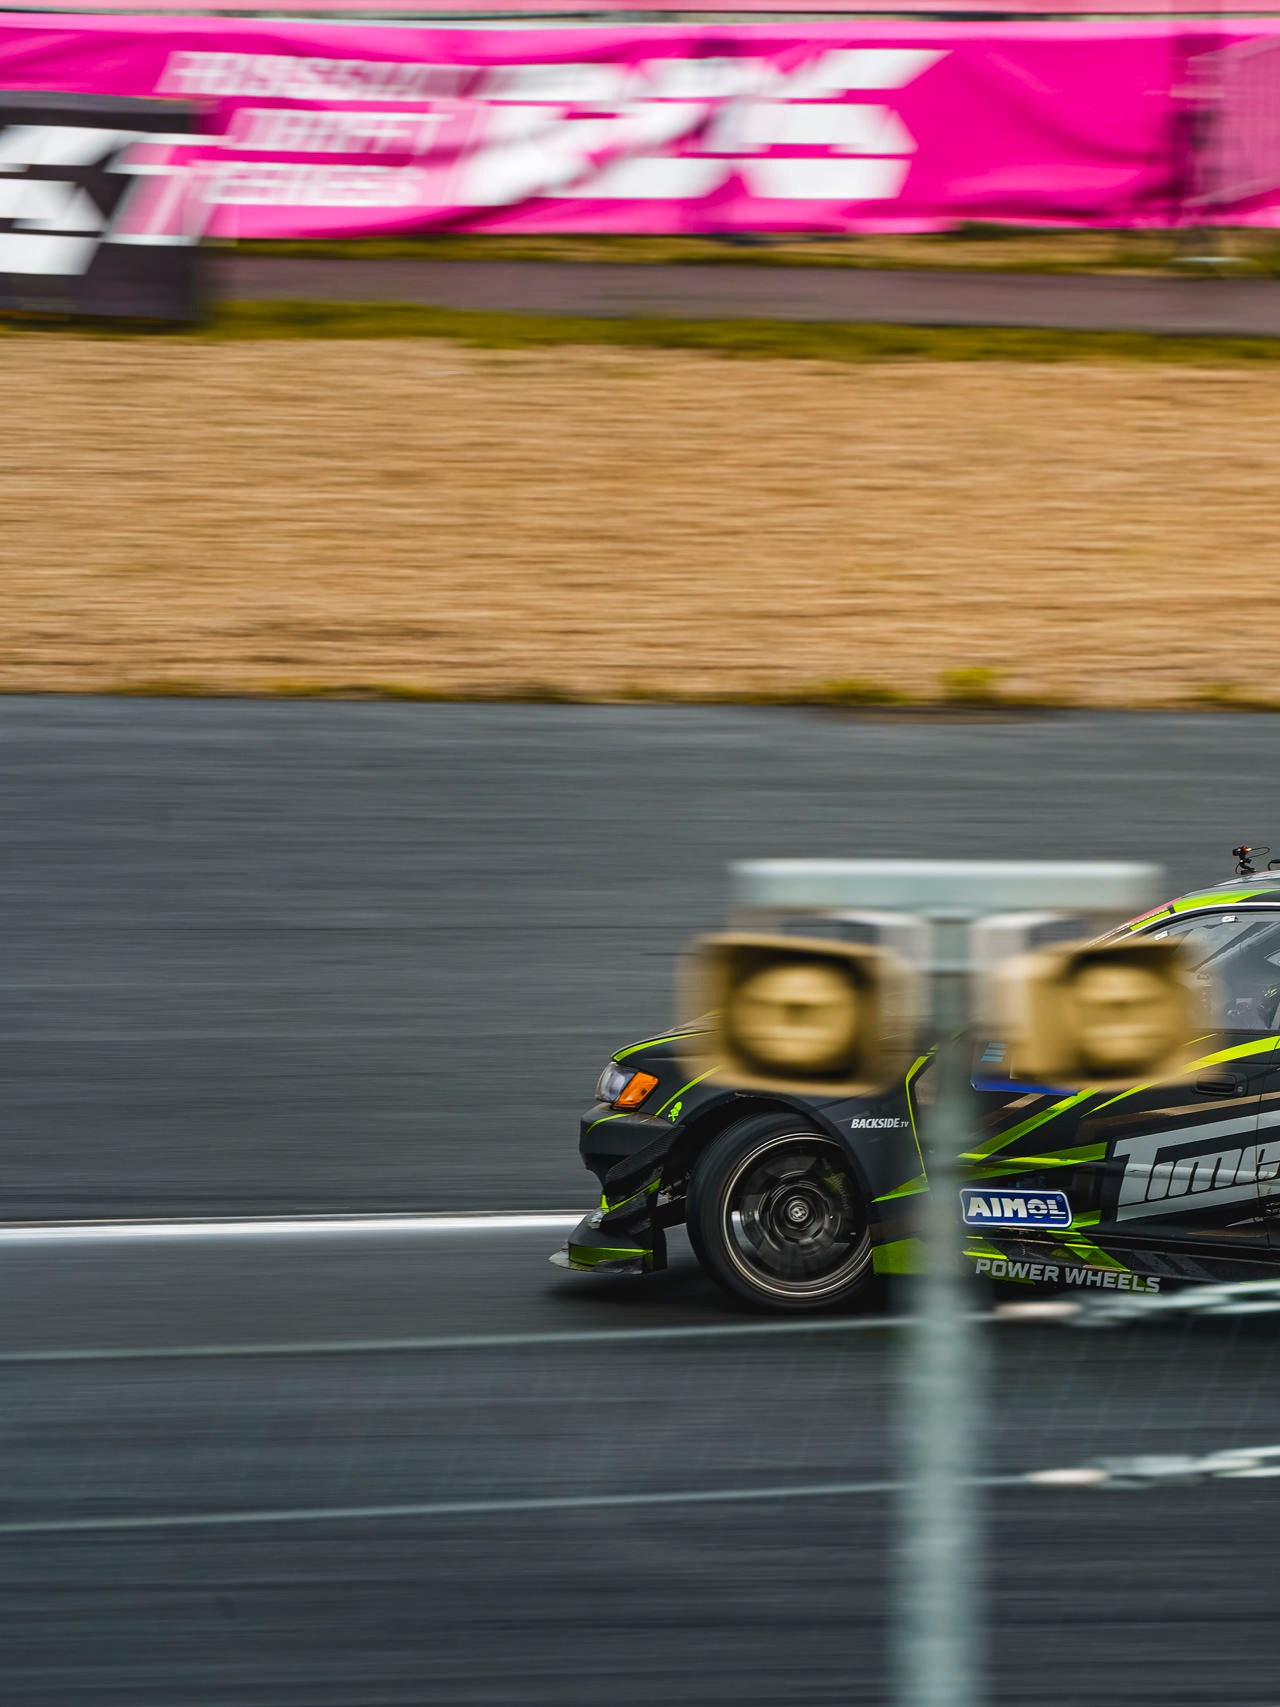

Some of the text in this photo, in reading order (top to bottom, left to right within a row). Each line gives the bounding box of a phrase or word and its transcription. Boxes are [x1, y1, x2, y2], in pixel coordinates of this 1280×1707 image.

[967, 1196, 1067, 1219] AIMOL
[976, 1259, 1162, 1293] POWER WHEELS
